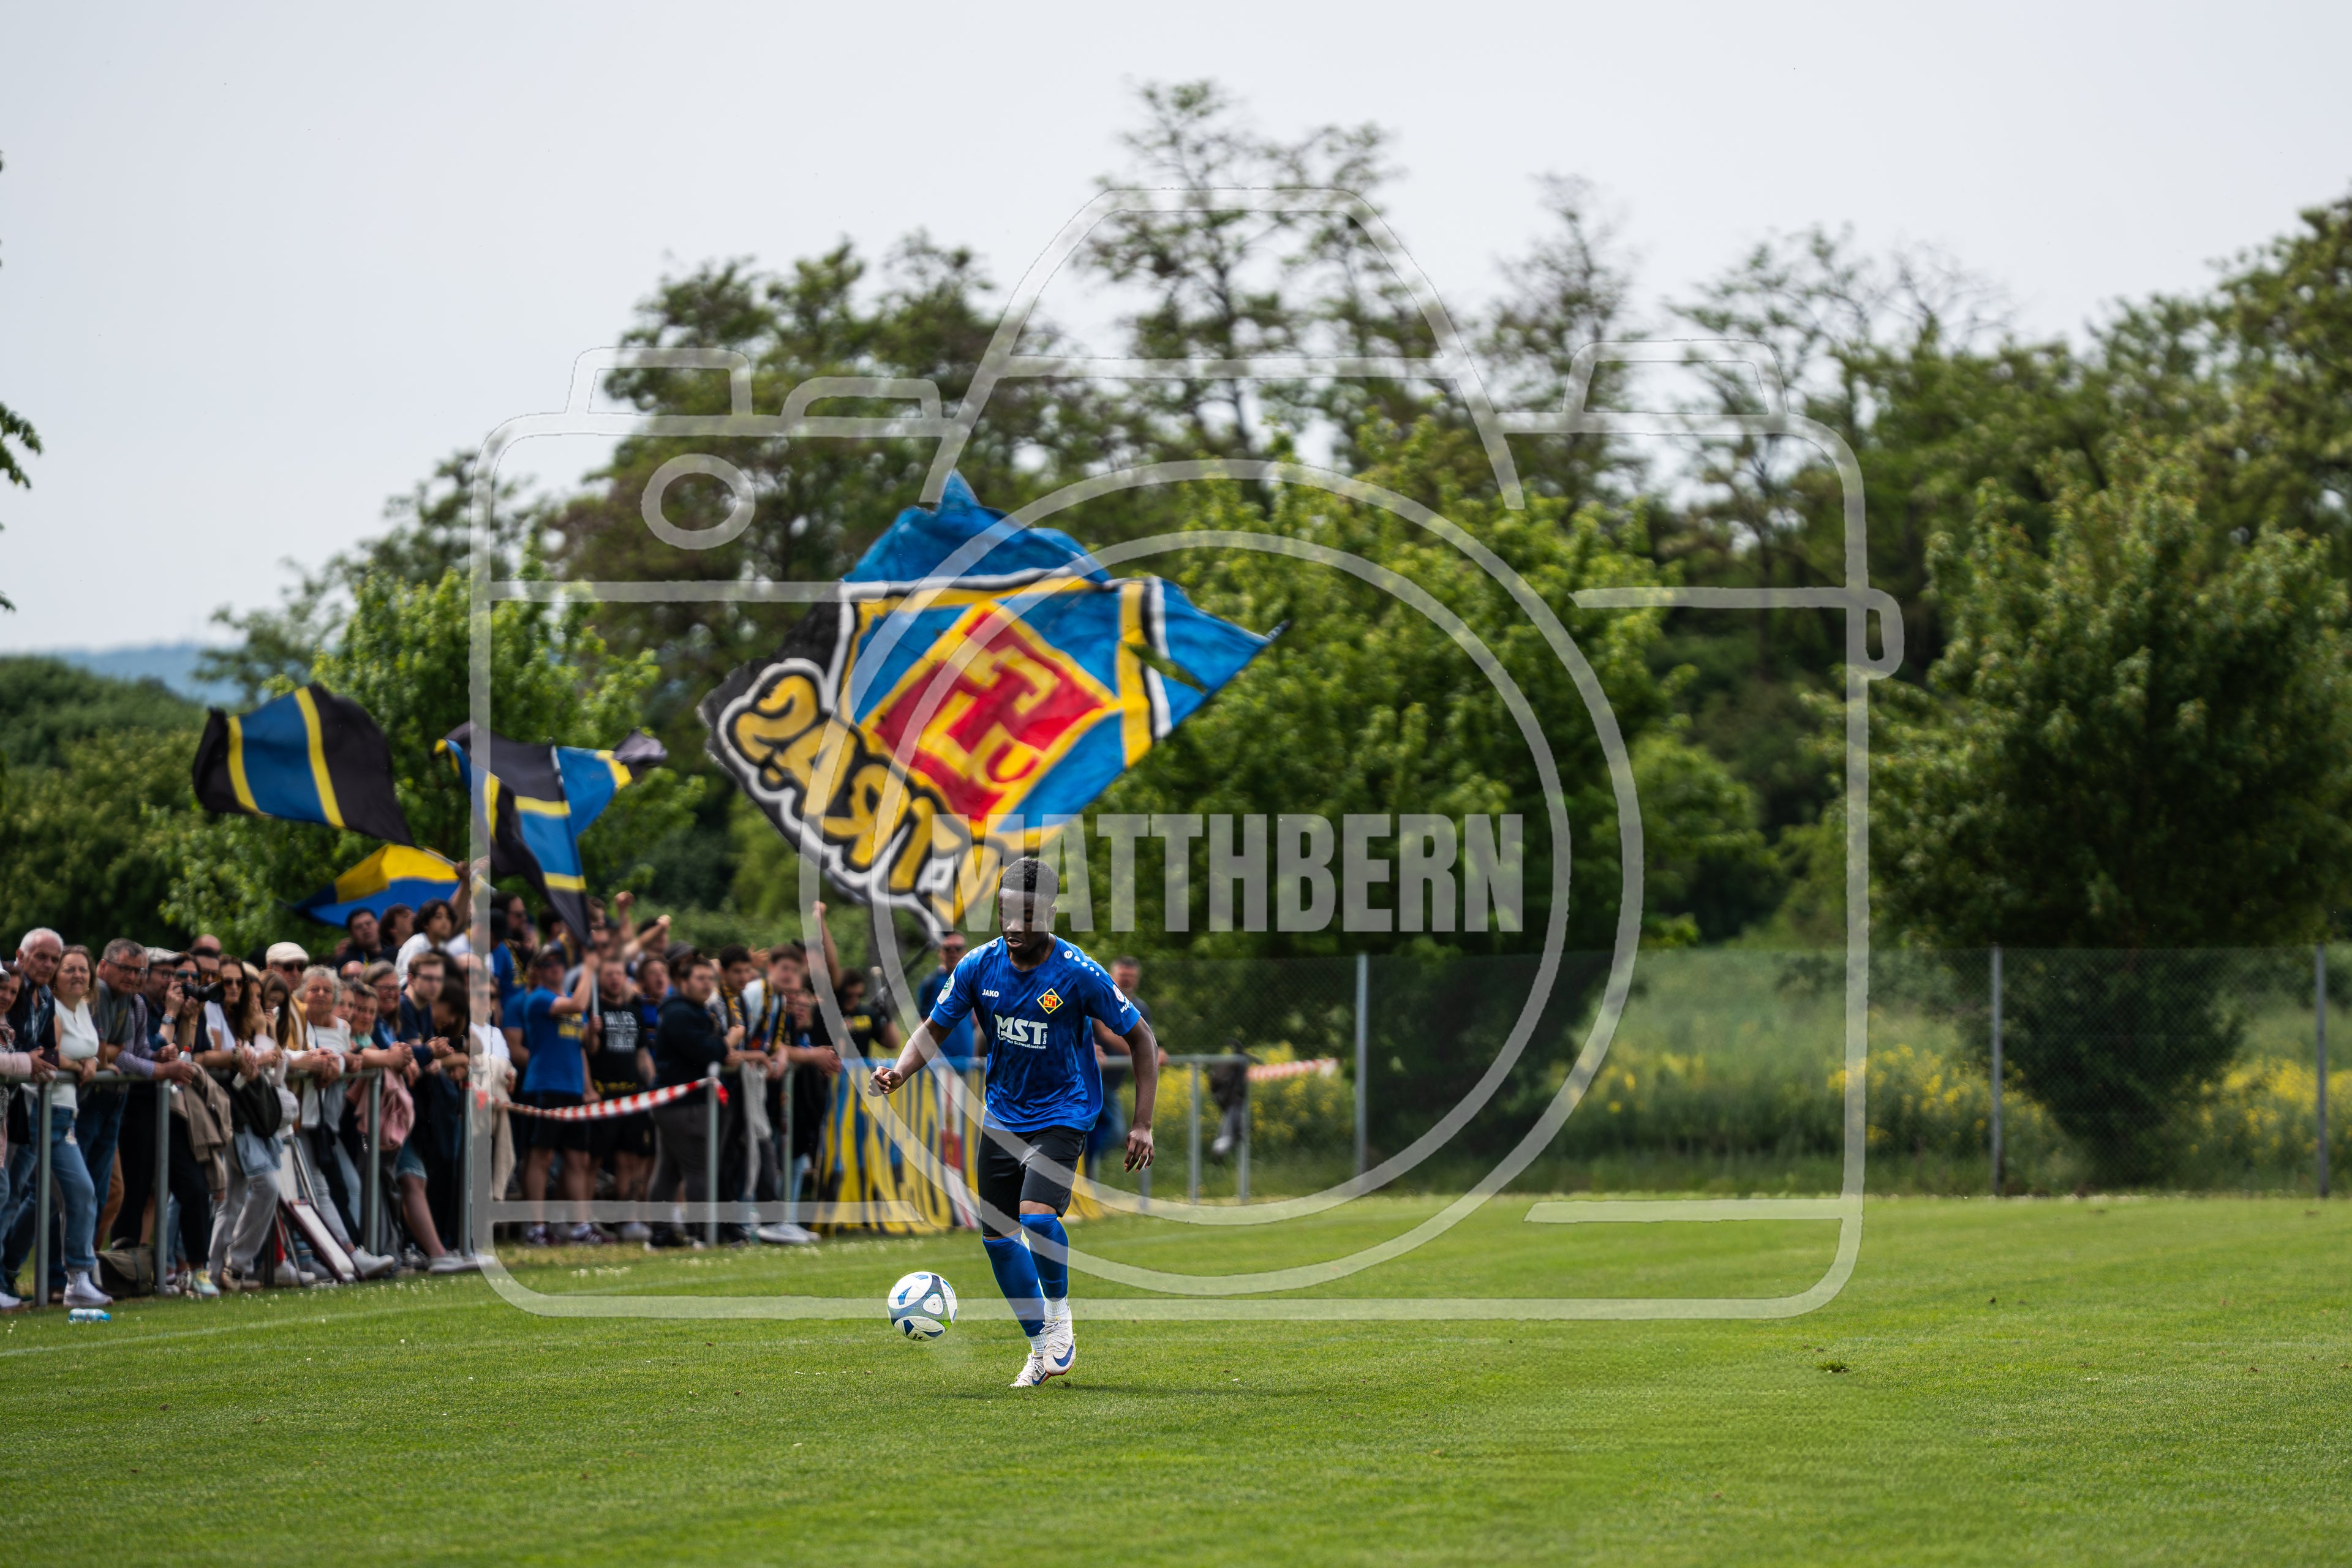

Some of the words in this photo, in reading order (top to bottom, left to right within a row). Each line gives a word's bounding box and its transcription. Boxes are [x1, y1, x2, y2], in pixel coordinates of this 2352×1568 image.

[982, 989, 1000, 998] JAKO
[994, 1014, 1048, 1045] MST
[1014, 1040, 1047, 1049] Schweißtechnik
